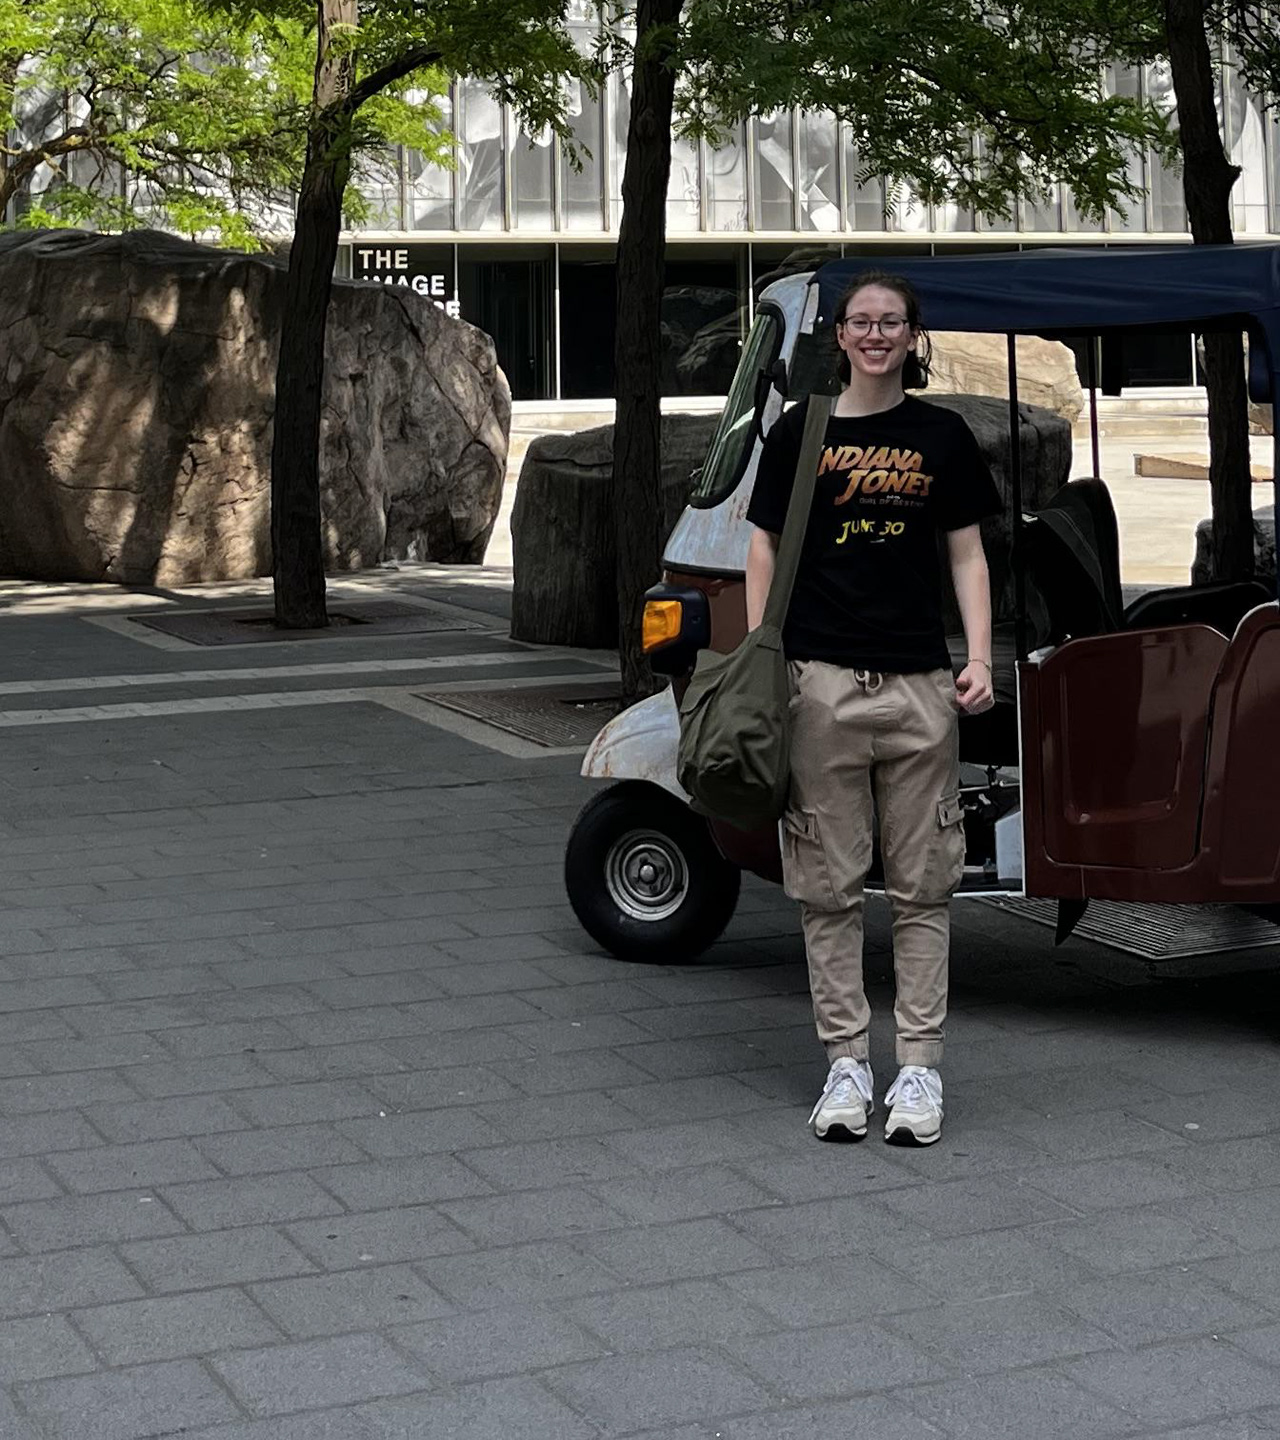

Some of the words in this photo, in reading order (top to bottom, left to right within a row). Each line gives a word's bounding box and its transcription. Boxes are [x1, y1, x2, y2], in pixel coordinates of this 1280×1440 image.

[358, 249, 408, 269] THE
[362, 275, 445, 295] AGE
[818, 445, 923, 477] NDIANA
[878, 521, 905, 536] 30
